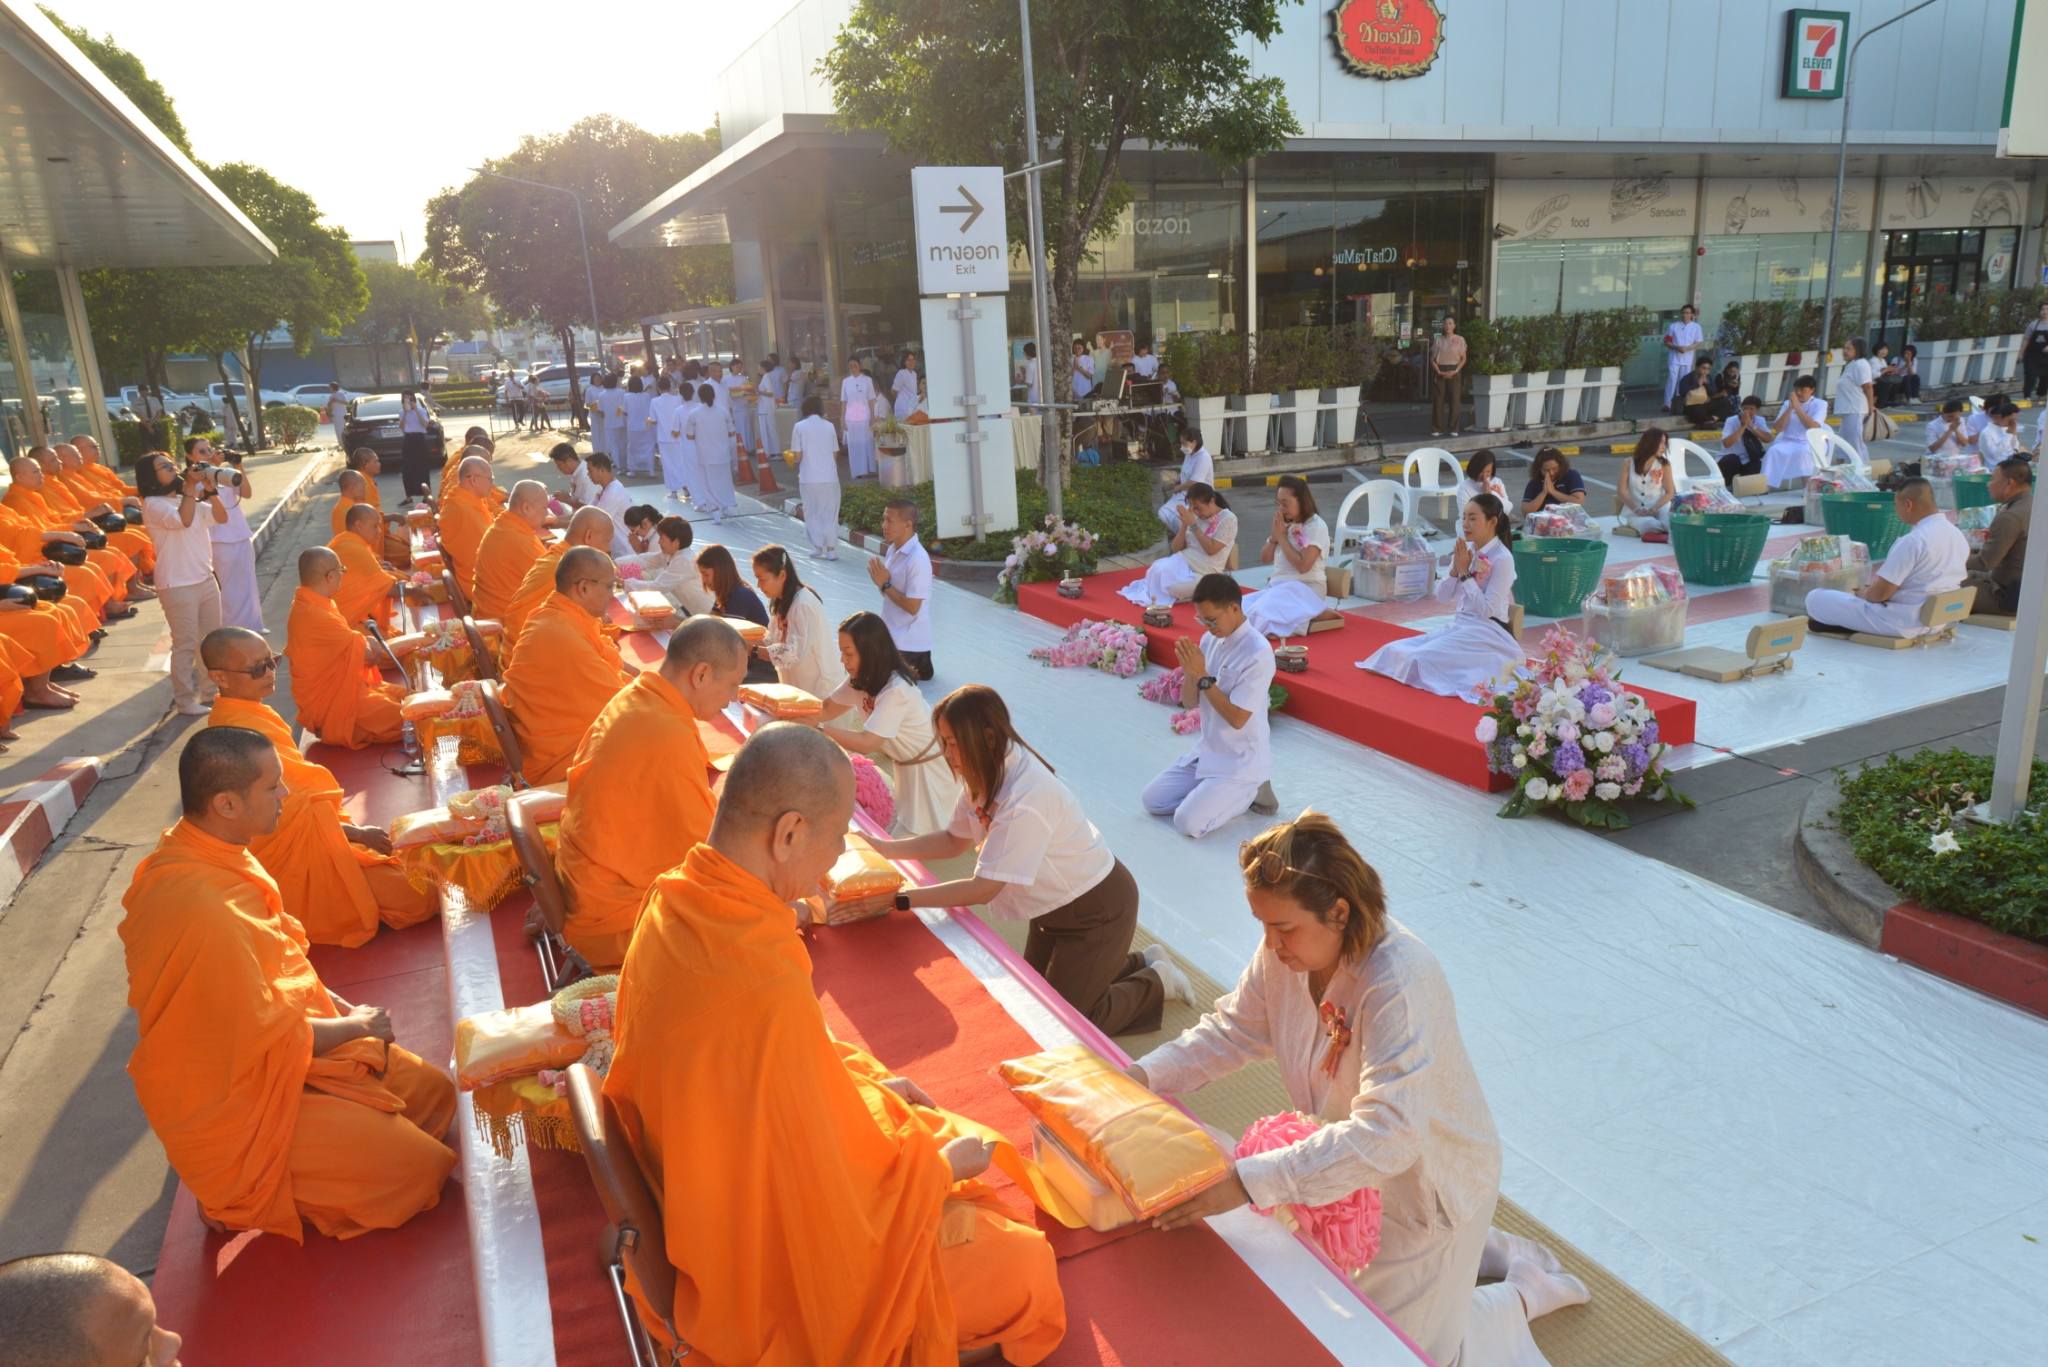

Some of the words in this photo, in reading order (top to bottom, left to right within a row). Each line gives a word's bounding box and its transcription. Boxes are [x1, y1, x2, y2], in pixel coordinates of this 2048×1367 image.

[1806, 25, 1837, 91] 7
[1650, 207, 1687, 218] Sandwich
[1750, 207, 1770, 218] Drink
[1570, 216, 1590, 228] food
[929, 244, 1000, 262] ทางออก
[955, 264, 977, 275] Exit
